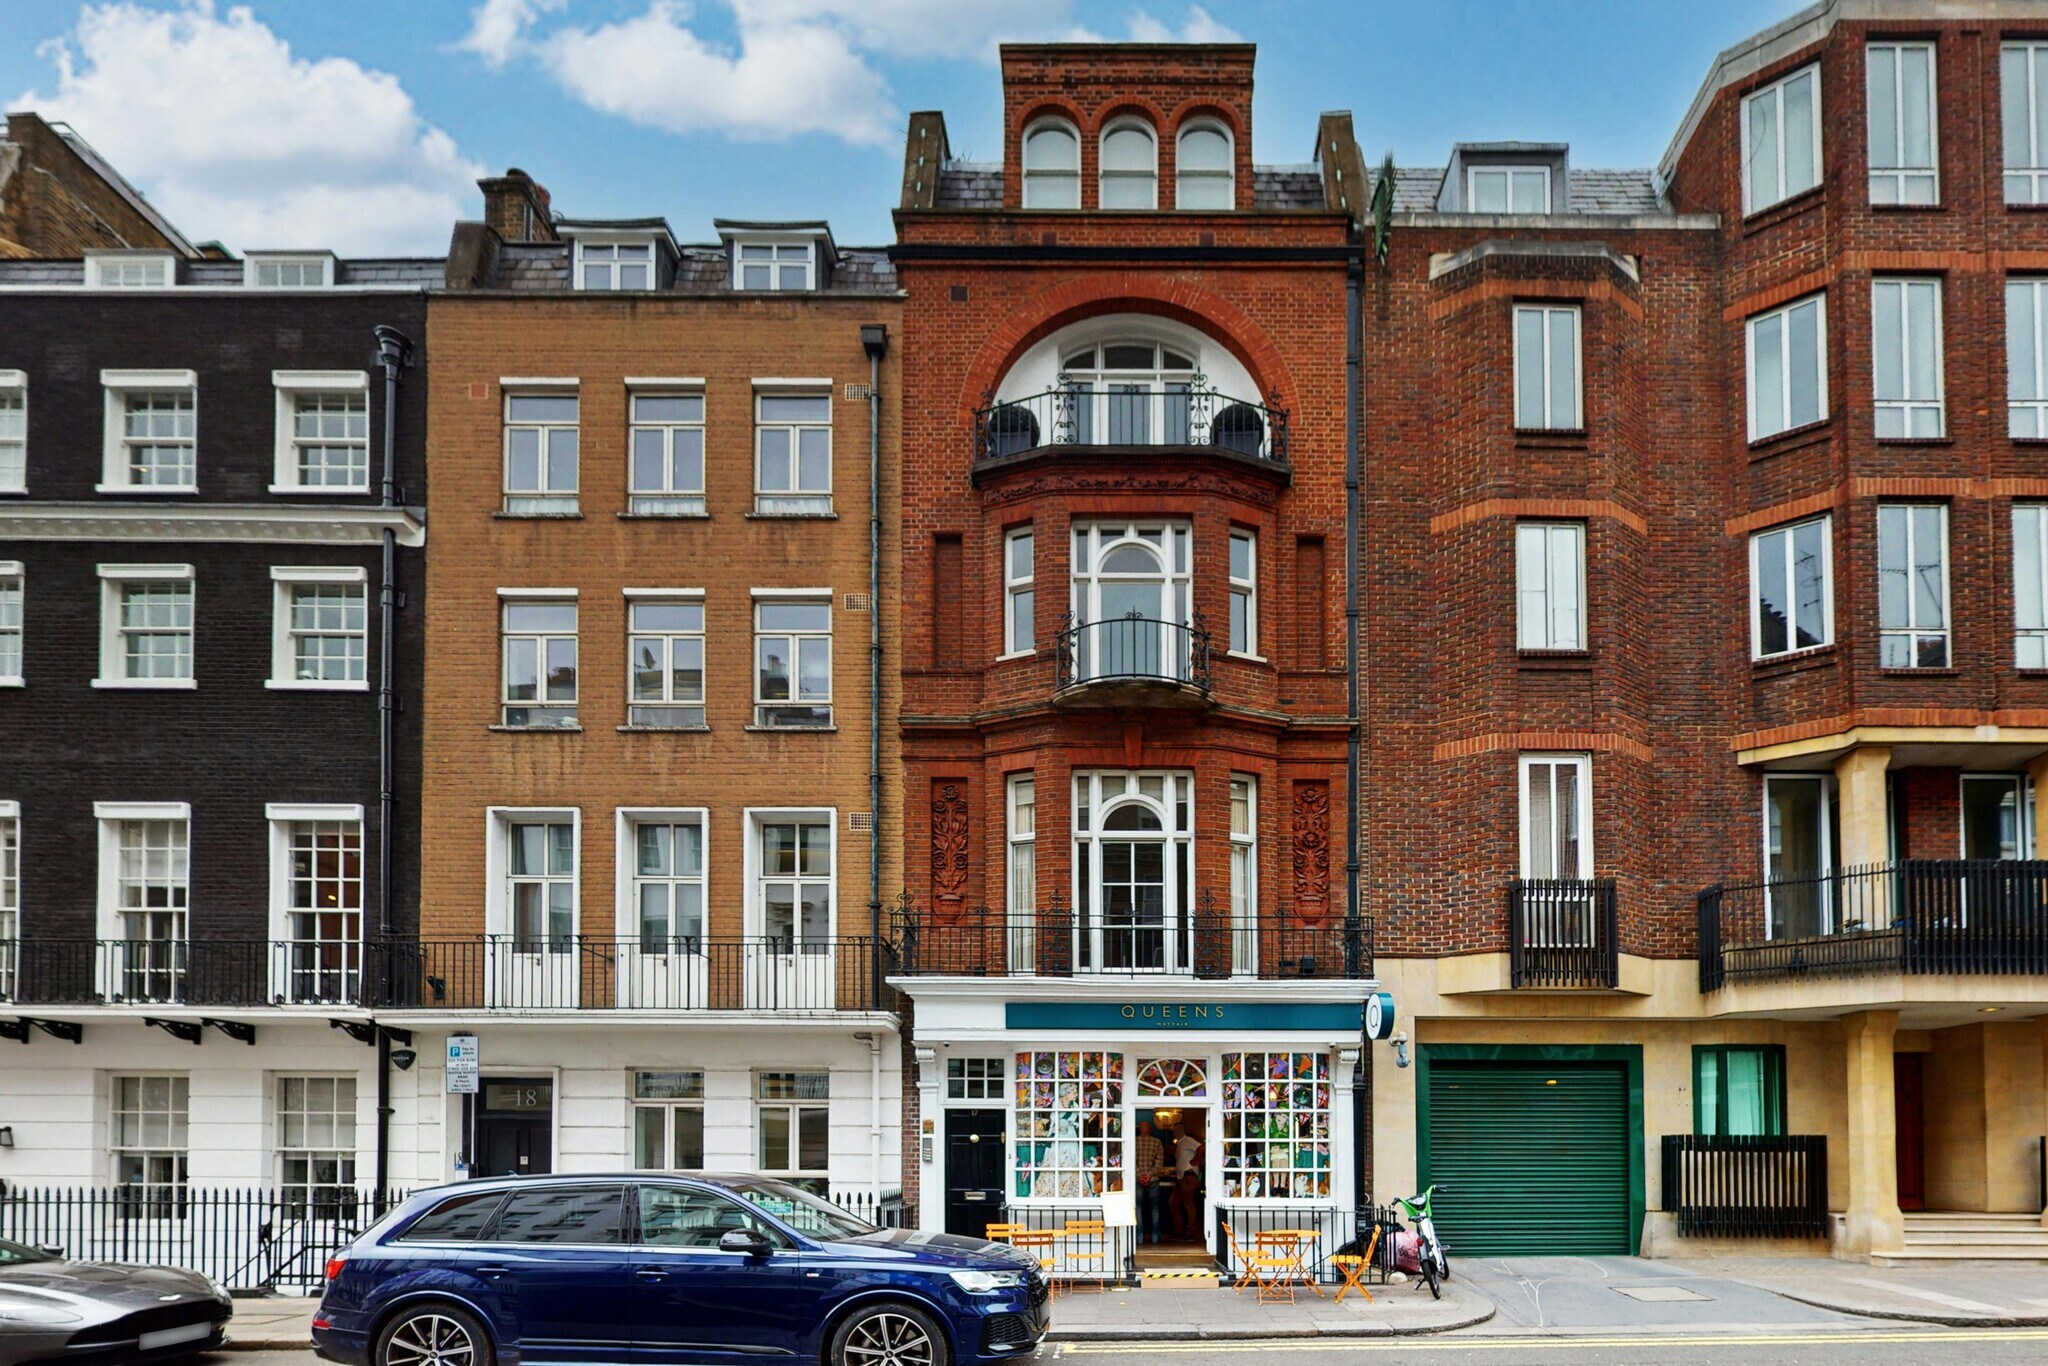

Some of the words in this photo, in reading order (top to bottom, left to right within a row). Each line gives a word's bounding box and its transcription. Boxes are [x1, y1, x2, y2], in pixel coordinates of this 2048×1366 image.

[1121, 1005, 1224, 1018] QUEENS
[1370, 1005, 1379, 1028] Q
[516, 1089, 537, 1107] 18
